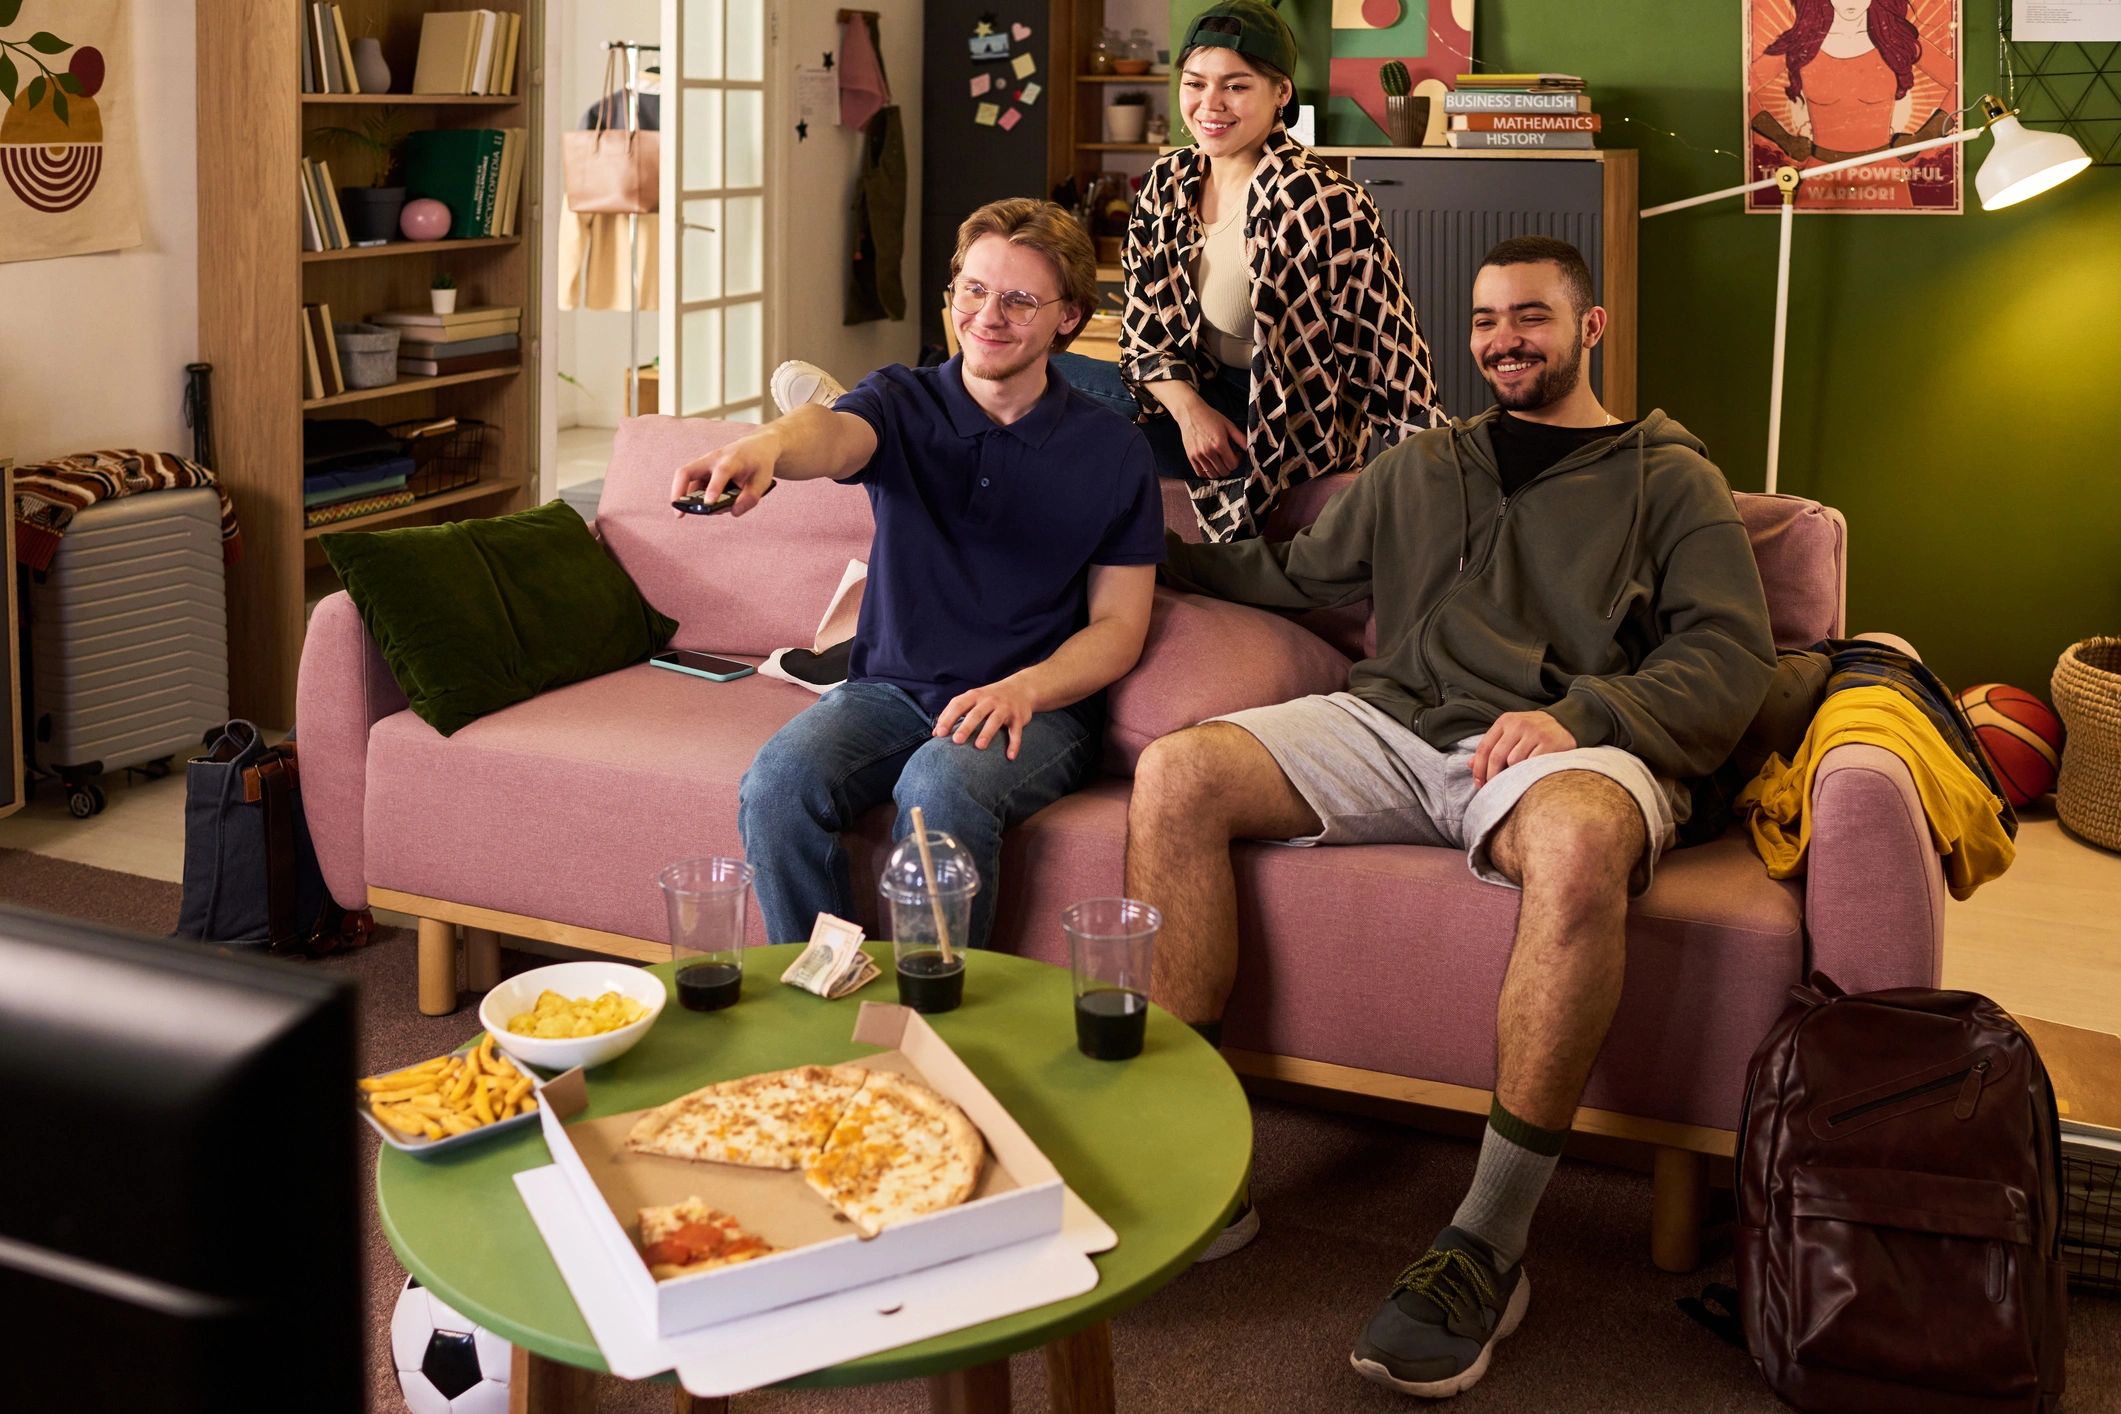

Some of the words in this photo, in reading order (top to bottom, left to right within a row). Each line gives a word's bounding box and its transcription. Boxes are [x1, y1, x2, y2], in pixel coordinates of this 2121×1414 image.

[1446, 95, 1511, 108] BUSINESS
[1514, 95, 1574, 108] ENGLISH
[1493, 117, 1593, 130] MATHEMATICS
[1486, 133, 1546, 145] HISTORY
[1847, 167, 1944, 181] POWERFUL
[483, 151, 500, 235] ENCYCLOPEDIA
[1807, 186, 1895, 201] WARRIOR!
